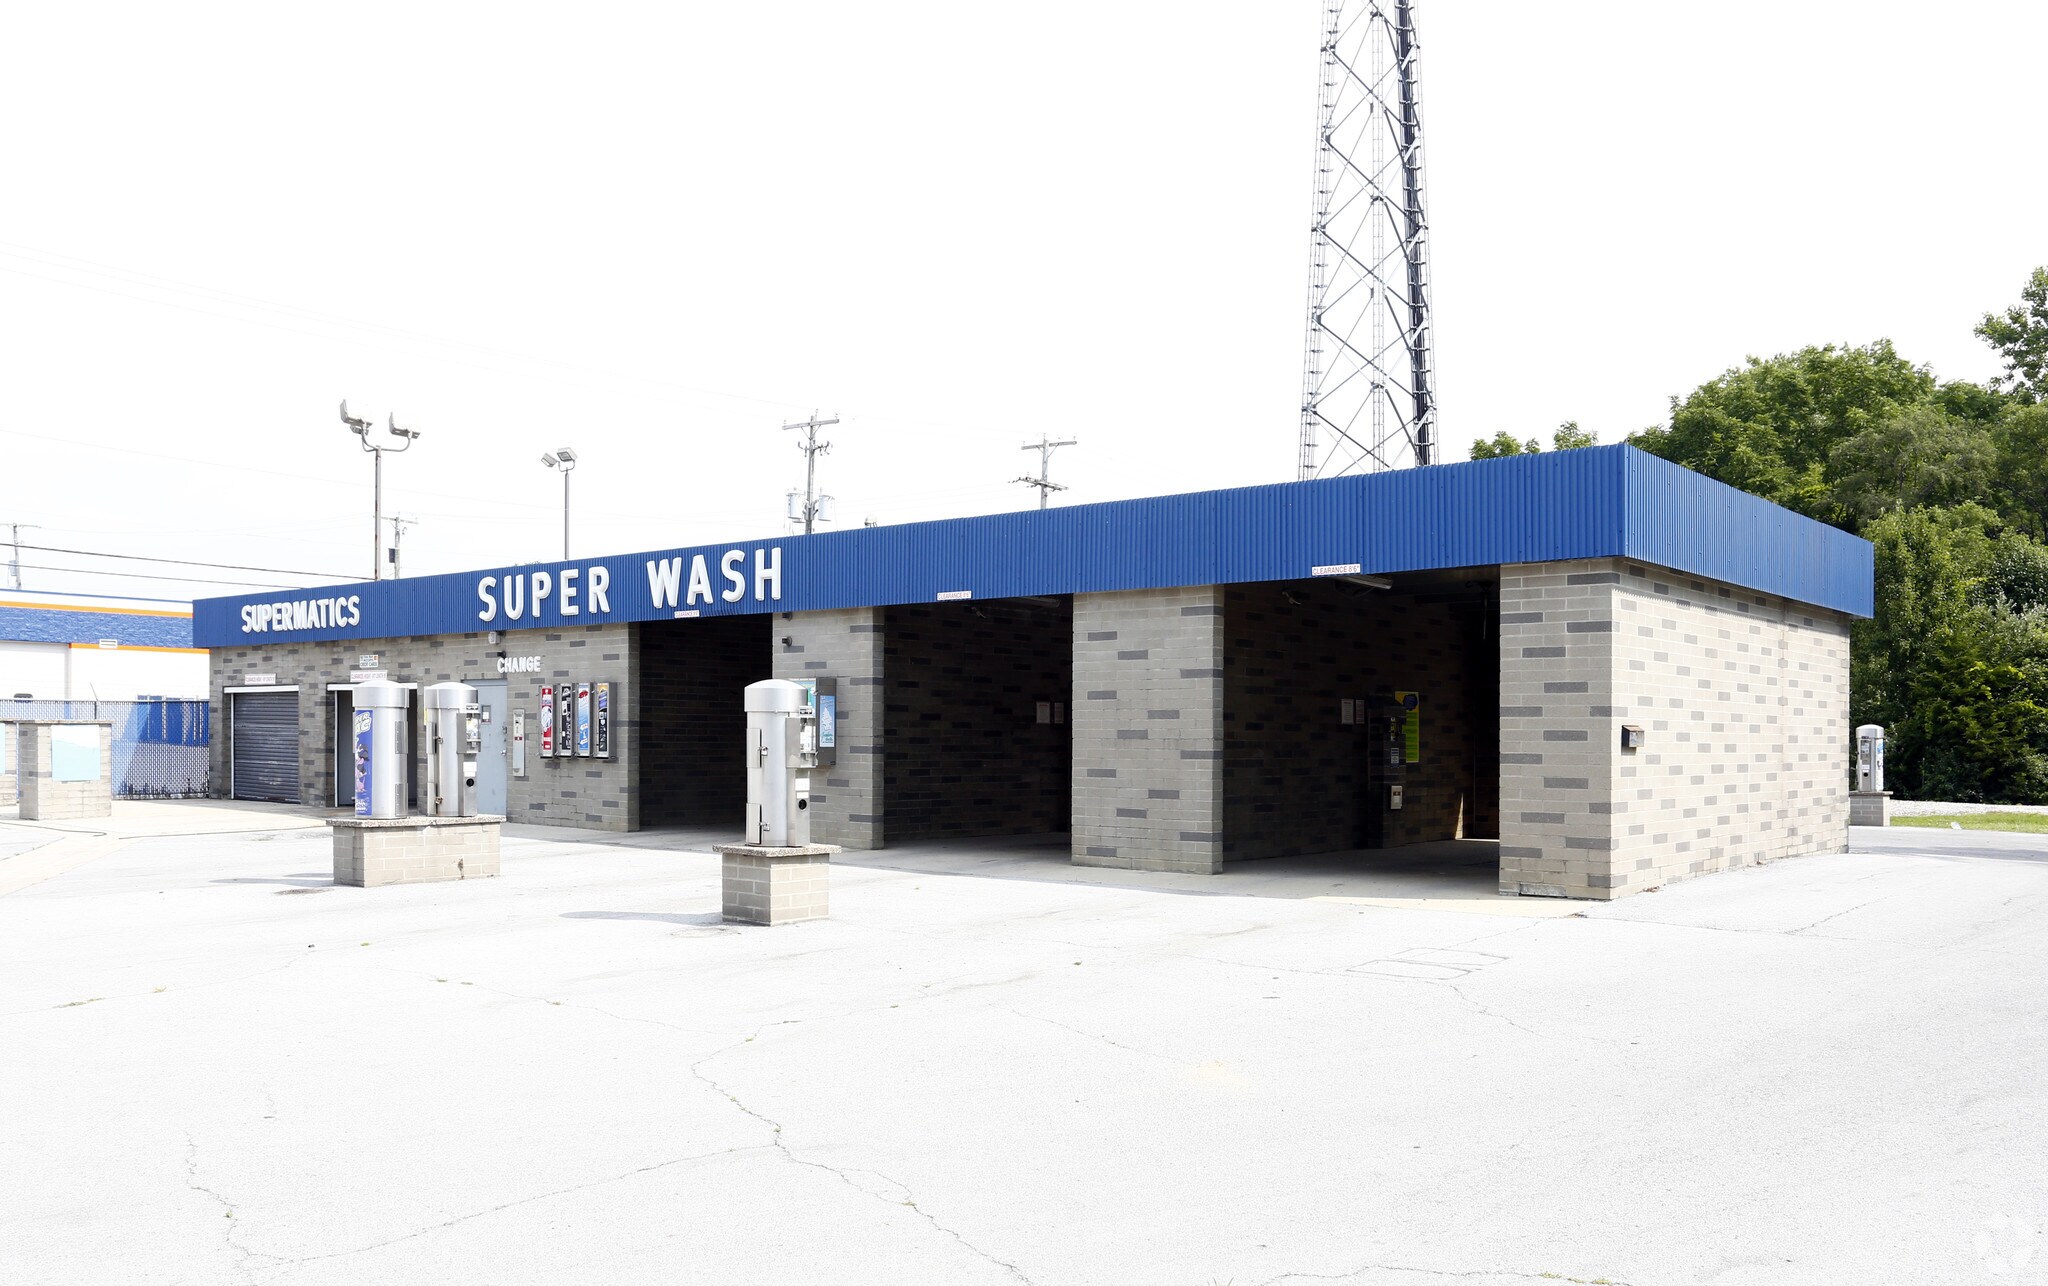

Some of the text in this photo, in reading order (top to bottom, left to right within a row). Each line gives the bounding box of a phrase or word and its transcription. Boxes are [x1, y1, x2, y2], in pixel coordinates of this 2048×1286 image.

[1312, 566, 1348, 575] CLEARANCE
[477, 547, 783, 622] SUPER WASH
[938, 592, 962, 600] CLEARANCE
[241, 595, 360, 633] SUPERMATICS
[497, 655, 541, 674] CHANGE
